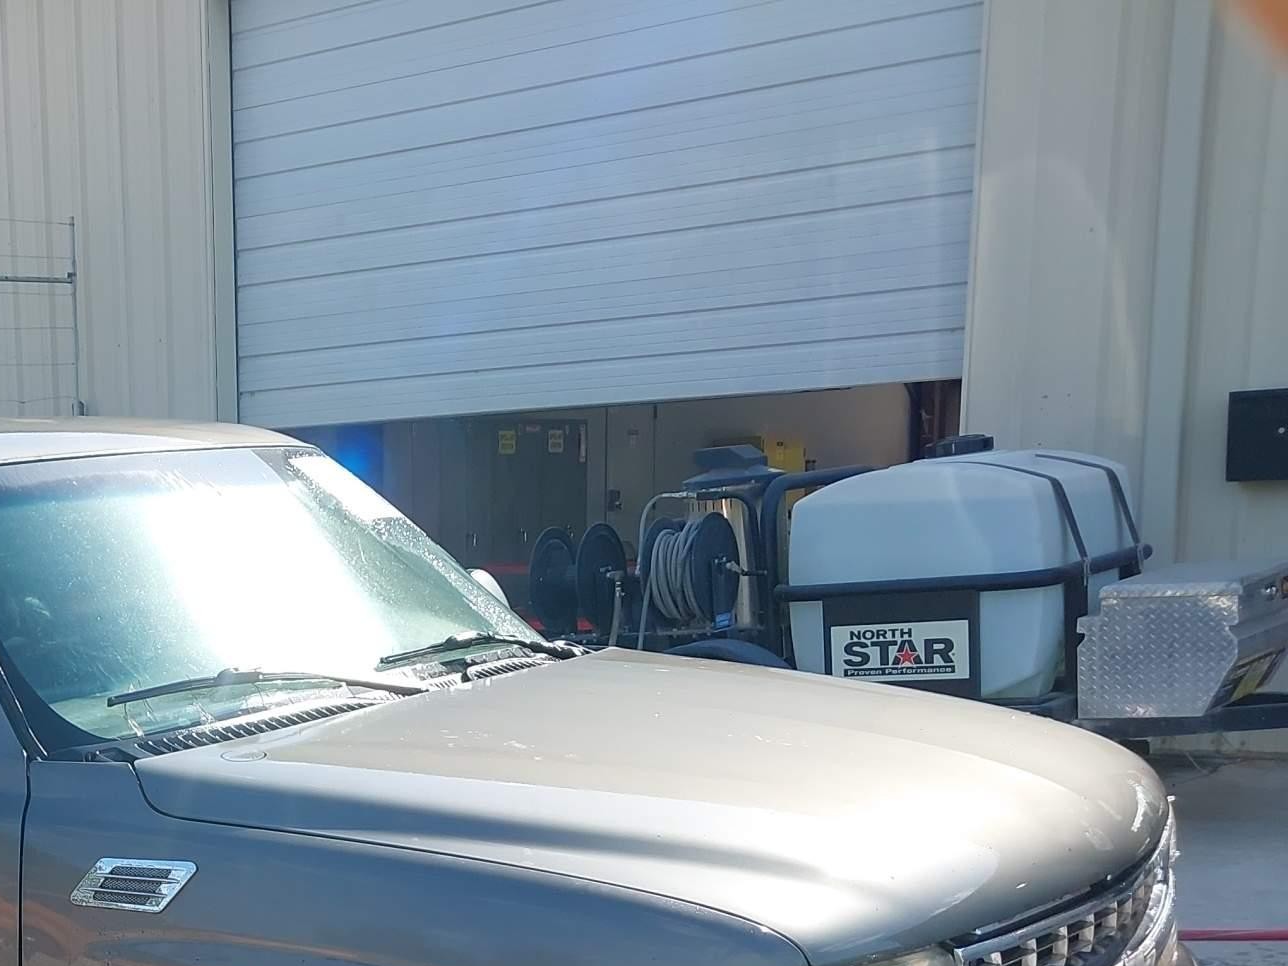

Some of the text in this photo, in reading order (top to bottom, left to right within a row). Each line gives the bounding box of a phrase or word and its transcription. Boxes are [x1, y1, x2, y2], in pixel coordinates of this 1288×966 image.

[849, 627, 913, 641] NORTH
[842, 637, 955, 668] STAR
[847, 665, 953, 676] Proven Performance
